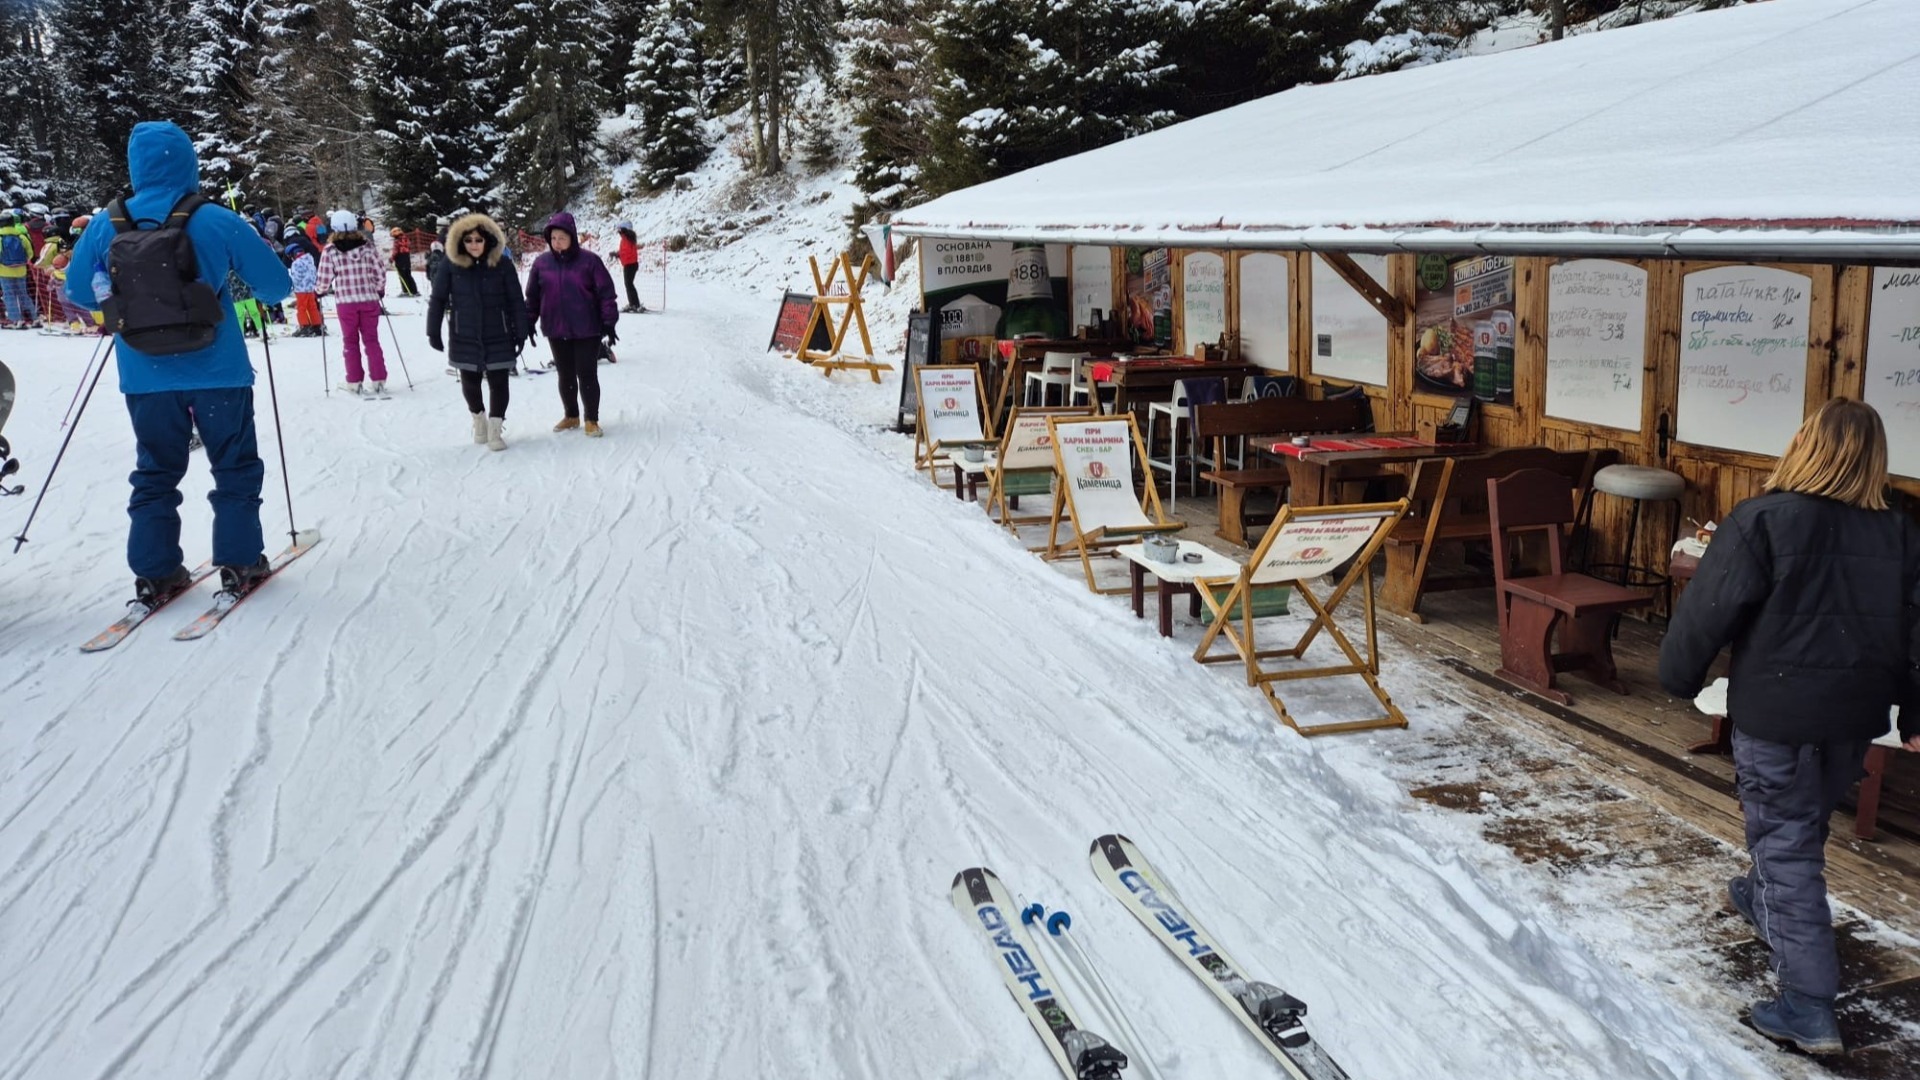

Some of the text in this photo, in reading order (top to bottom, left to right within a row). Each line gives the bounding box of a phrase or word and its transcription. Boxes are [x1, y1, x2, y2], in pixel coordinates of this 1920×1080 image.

[936, 240, 992, 252] ОСНОВАНА
[956, 254, 974, 263] 1881
[938, 264, 992, 275] В ПЛОВДИВ
[1015, 263, 1044, 280] 1881
[1454, 264, 1480, 282] КОМБО
[1697, 279, 1778, 301] пататник
[933, 409, 970, 419] Каменица
[1077, 477, 1122, 490] Каменица
[1323, 525, 1370, 533] МАРИНА
[1267, 557, 1333, 567] Каменица
[1119, 870, 1213, 956] HEAD
[978, 906, 1053, 1000] HEAD
